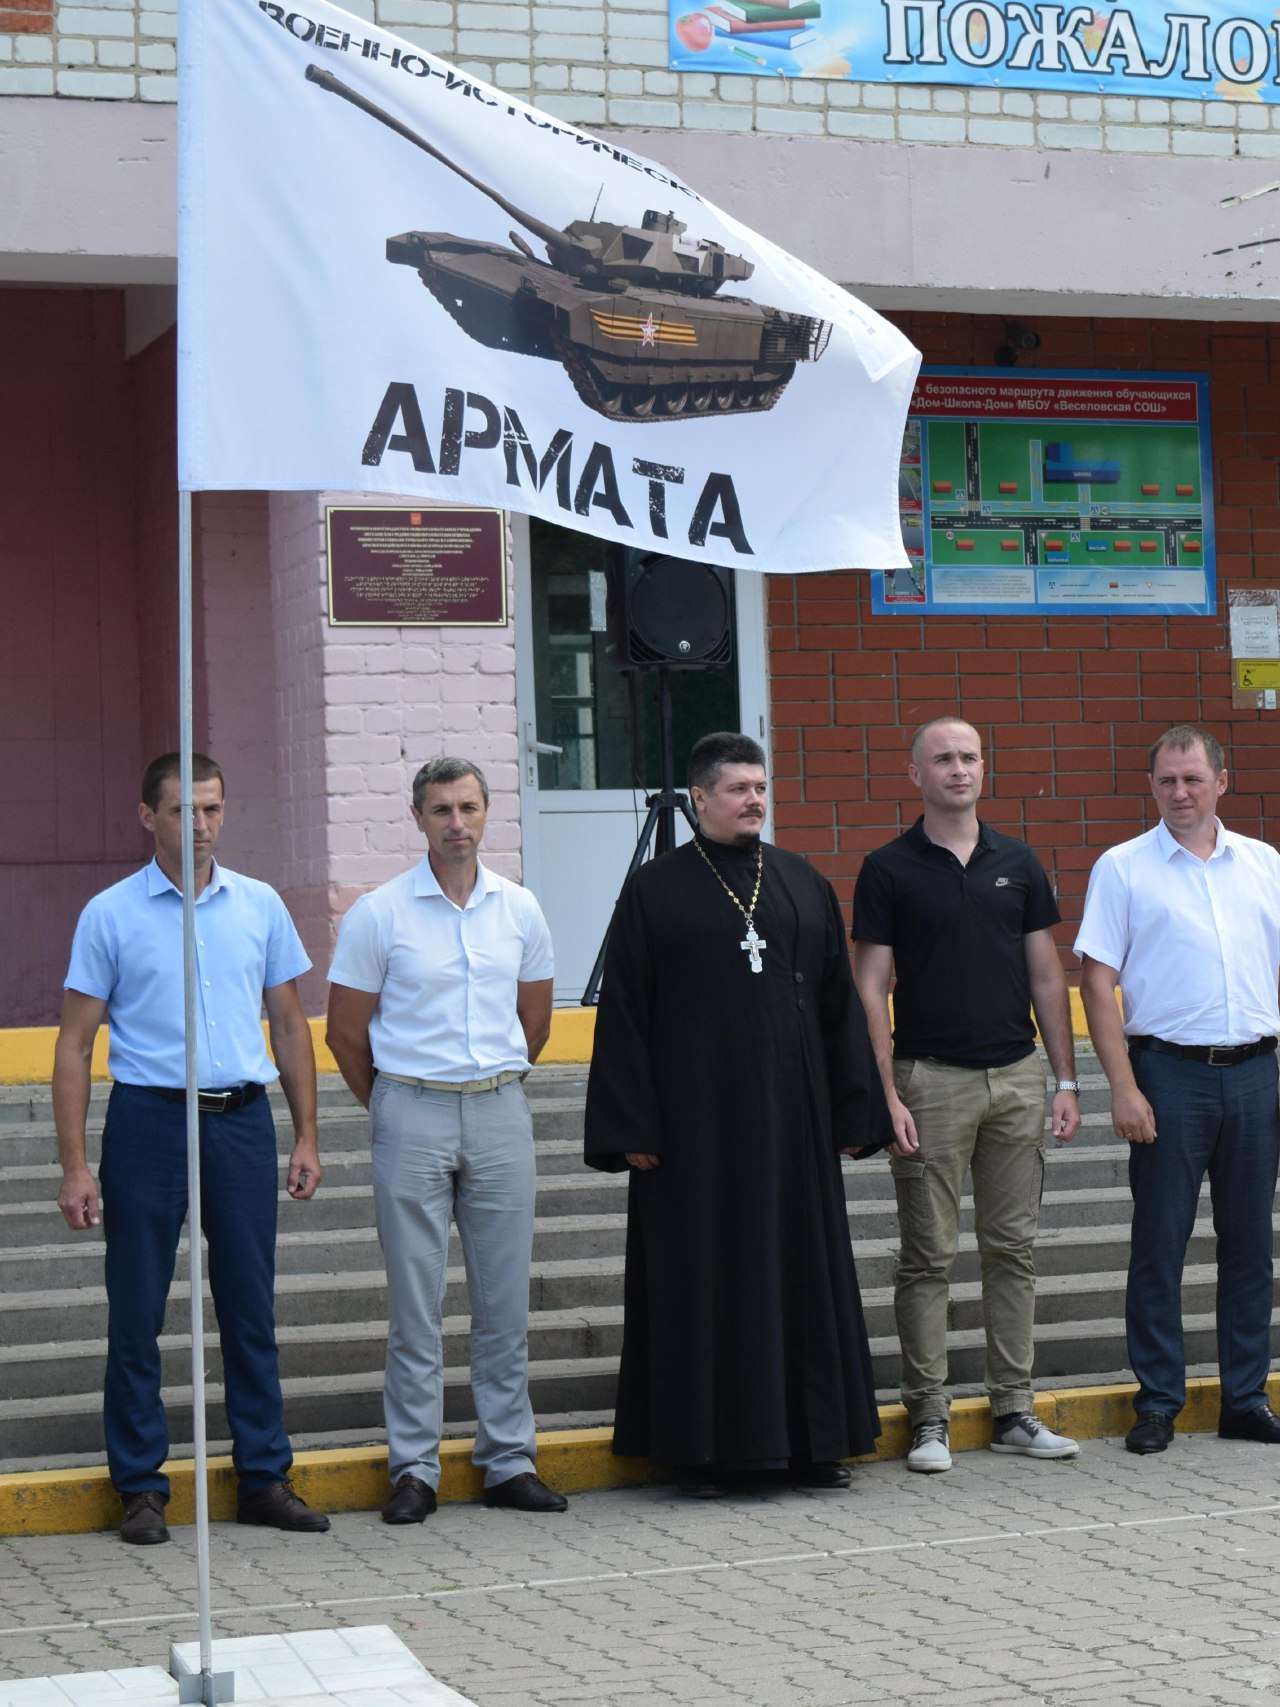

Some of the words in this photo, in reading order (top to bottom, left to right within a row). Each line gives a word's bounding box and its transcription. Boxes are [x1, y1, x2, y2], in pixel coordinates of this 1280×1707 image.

[926, 384, 996, 395] безопасного
[1000, 387, 1055, 398] маршрута
[1058, 388, 1113, 398] движения
[1116, 388, 1191, 400] обучающихся
[1018, 400, 1050, 410] МБОУ
[361, 382, 755, 555] АРМАТА
